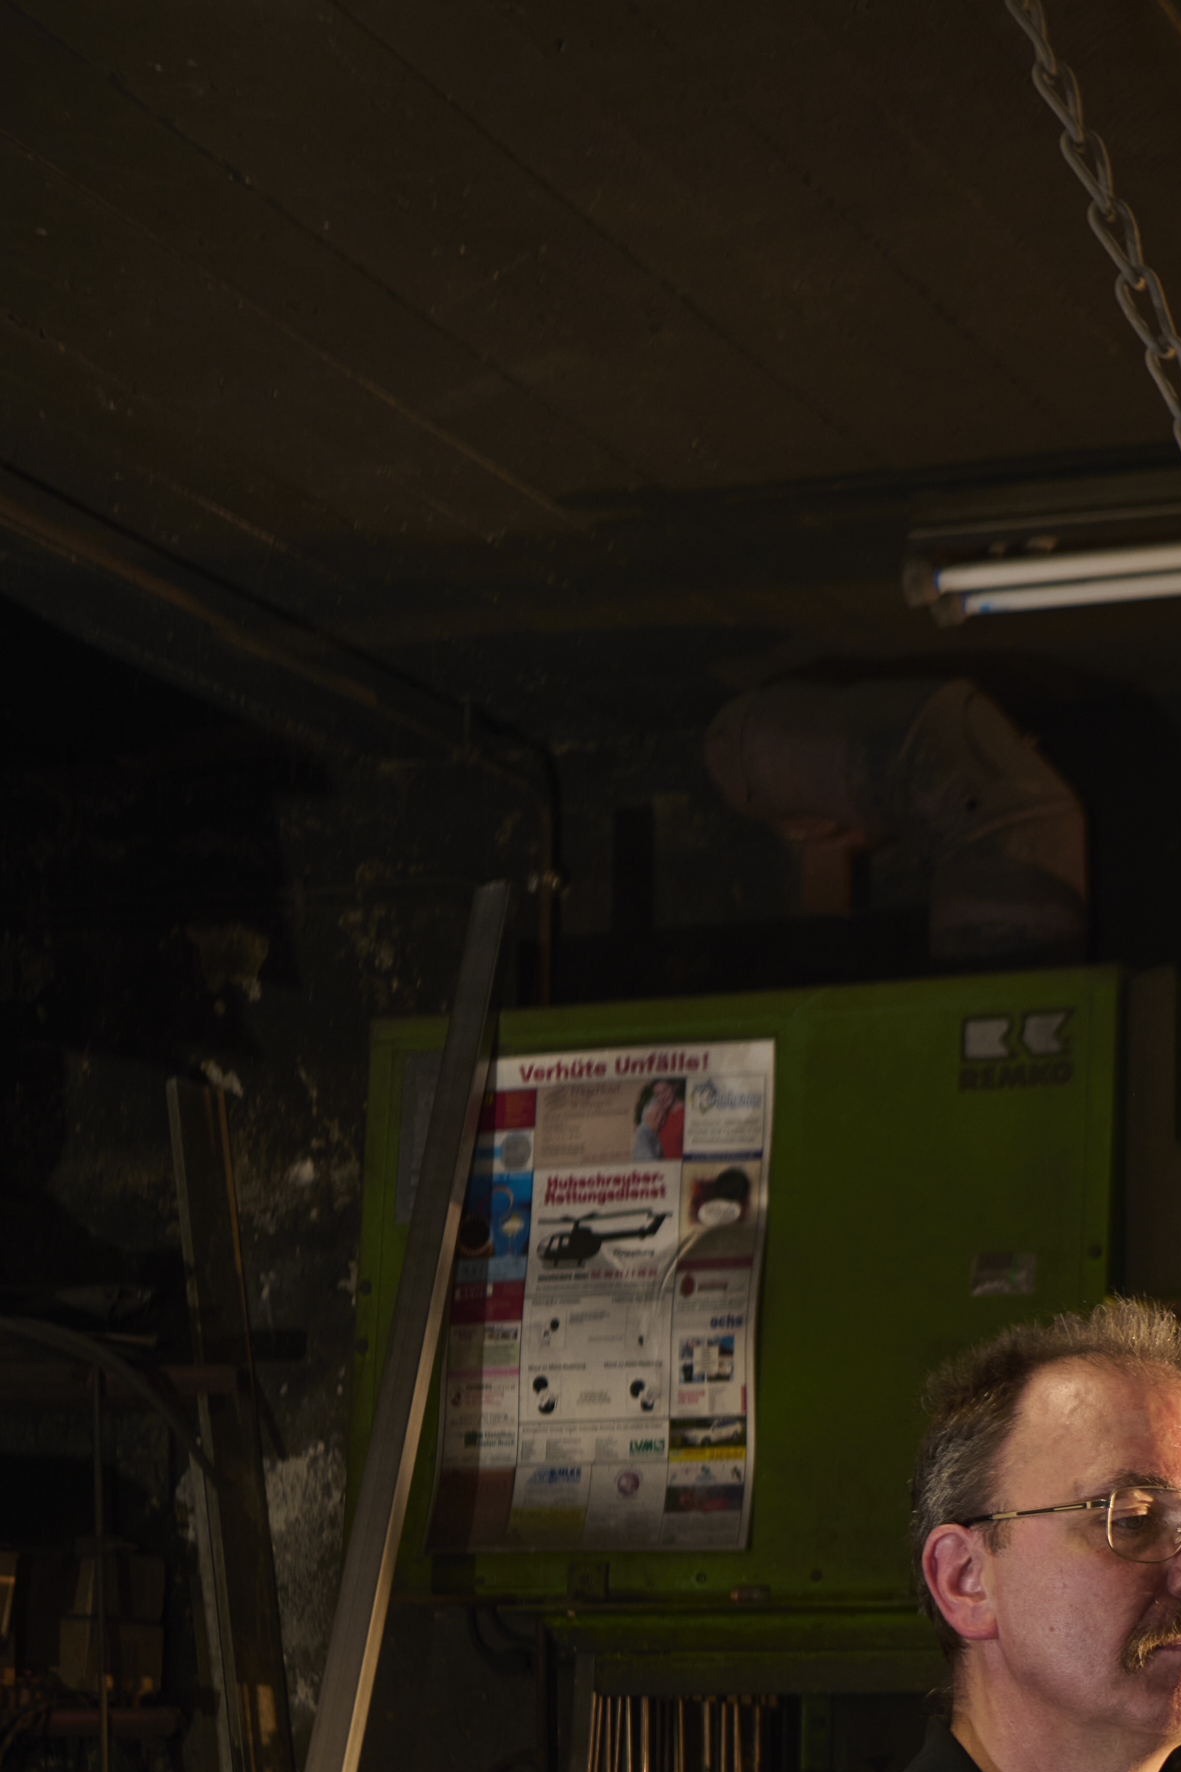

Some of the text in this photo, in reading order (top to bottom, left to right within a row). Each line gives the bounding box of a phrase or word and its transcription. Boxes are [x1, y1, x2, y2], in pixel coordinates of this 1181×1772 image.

[519, 1051, 709, 1083] Verhüte Unfälle!
[958, 1062, 1074, 1092] REMKO
[547, 1171, 664, 1191] Hubschrauber-
[545, 1182, 667, 1205] Rettungsdienst
[710, 1313, 743, 1329] ochs
[629, 1438, 654, 1454] LVM
